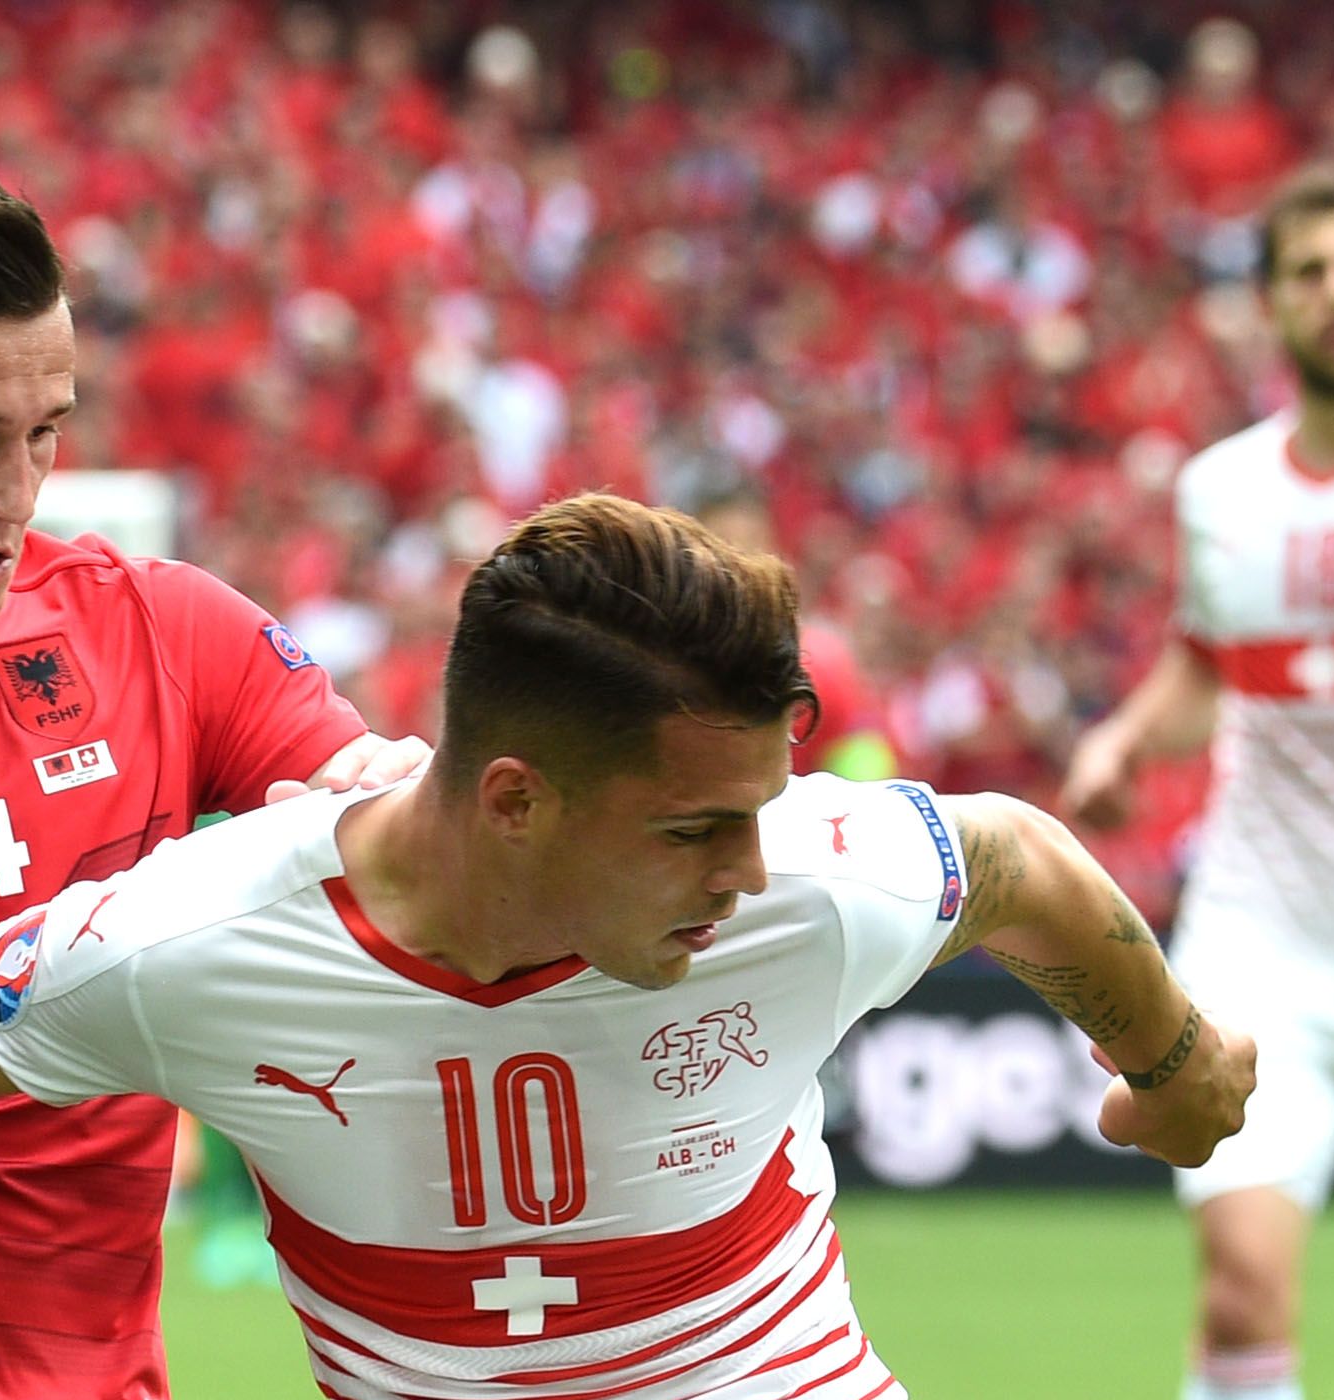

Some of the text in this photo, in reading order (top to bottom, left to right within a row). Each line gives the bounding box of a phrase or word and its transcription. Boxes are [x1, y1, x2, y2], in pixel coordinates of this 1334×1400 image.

[35, 703, 83, 728] FSHF
[435, 1052, 587, 1227] 10
[657, 1147, 693, 1170] ALB
[711, 1136, 736, 1158] CH
